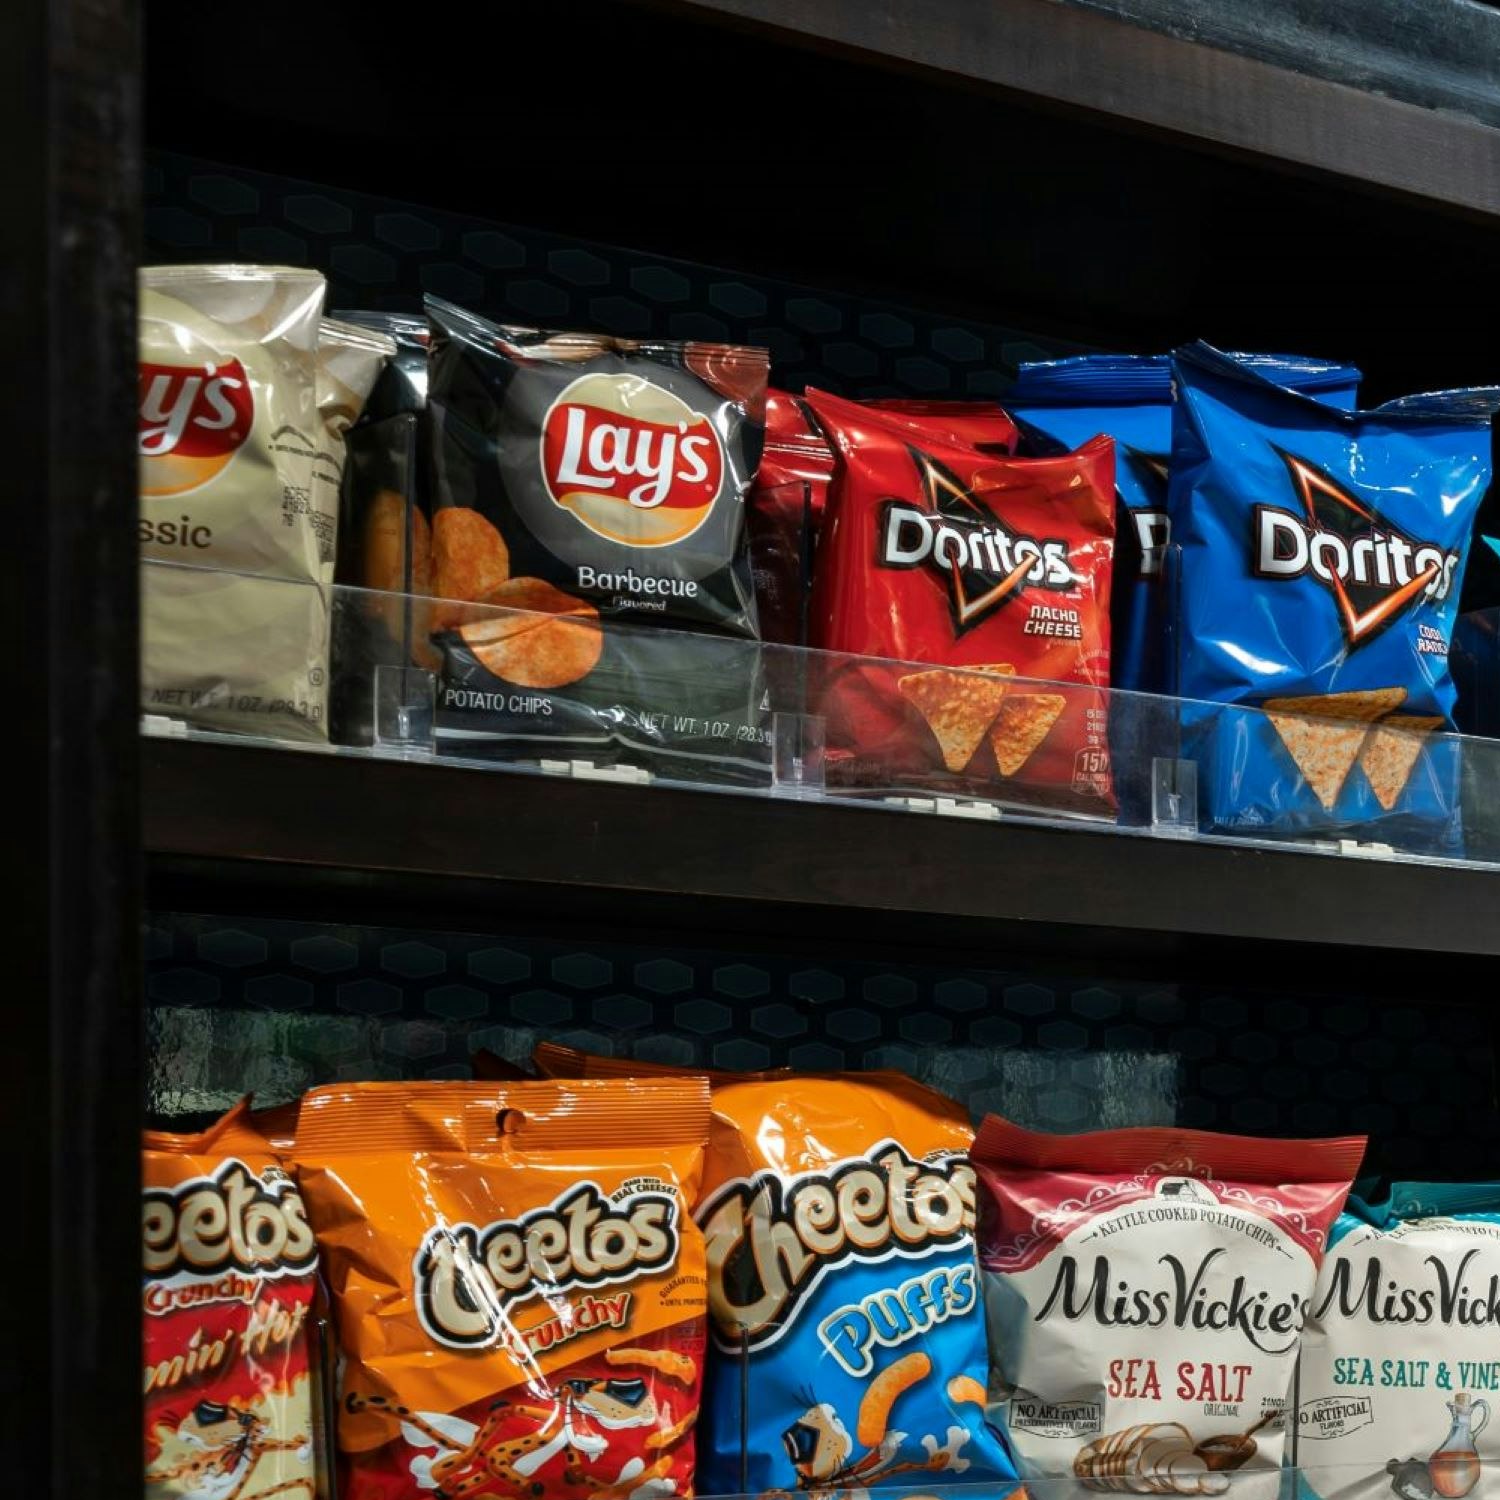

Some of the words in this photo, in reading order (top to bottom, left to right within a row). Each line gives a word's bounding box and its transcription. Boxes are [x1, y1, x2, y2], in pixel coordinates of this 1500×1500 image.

[556, 407, 710, 508] Lay's
[138, 515, 212, 549] ssic
[886, 507, 1074, 584] Doritos
[1259, 509, 1460, 601] Doritos
[577, 566, 699, 598] Barbecue
[1024, 621, 1082, 638] CHEESE
[1030, 605, 1078, 623] NACHO
[445, 690, 505, 711] POTATO
[509, 695, 553, 716] CHIPS
[144, 1168, 314, 1270] eetos
[706, 1150, 977, 1325] Cheetos
[1099, 1210, 1147, 1238] KETTLE
[1148, 1208, 1198, 1223] COOKED
[1199, 1208, 1246, 1233] POTATO
[1245, 1221, 1279, 1249] CHIPS
[428, 1192, 666, 1336] Cheetos
[147, 1276, 258, 1316] Crunchy
[1035, 1255, 1169, 1327] Miss
[1158, 1247, 1310, 1354] Vickie's
[1315, 1257, 1434, 1323] Miss
[241, 1299, 310, 1356] Hot
[823, 1267, 975, 1373] PUFFS
[1107, 1359, 1162, 1400] SEA
[1176, 1362, 1253, 1402] SALT
[1333, 1358, 1374, 1386] SEA
[1380, 1359, 1430, 1388] SALT
[1435, 1363, 1453, 1391] &
[1016, 1403, 1036, 1419] NO
[1311, 1402, 1369, 1425] ARTIFICIAL
